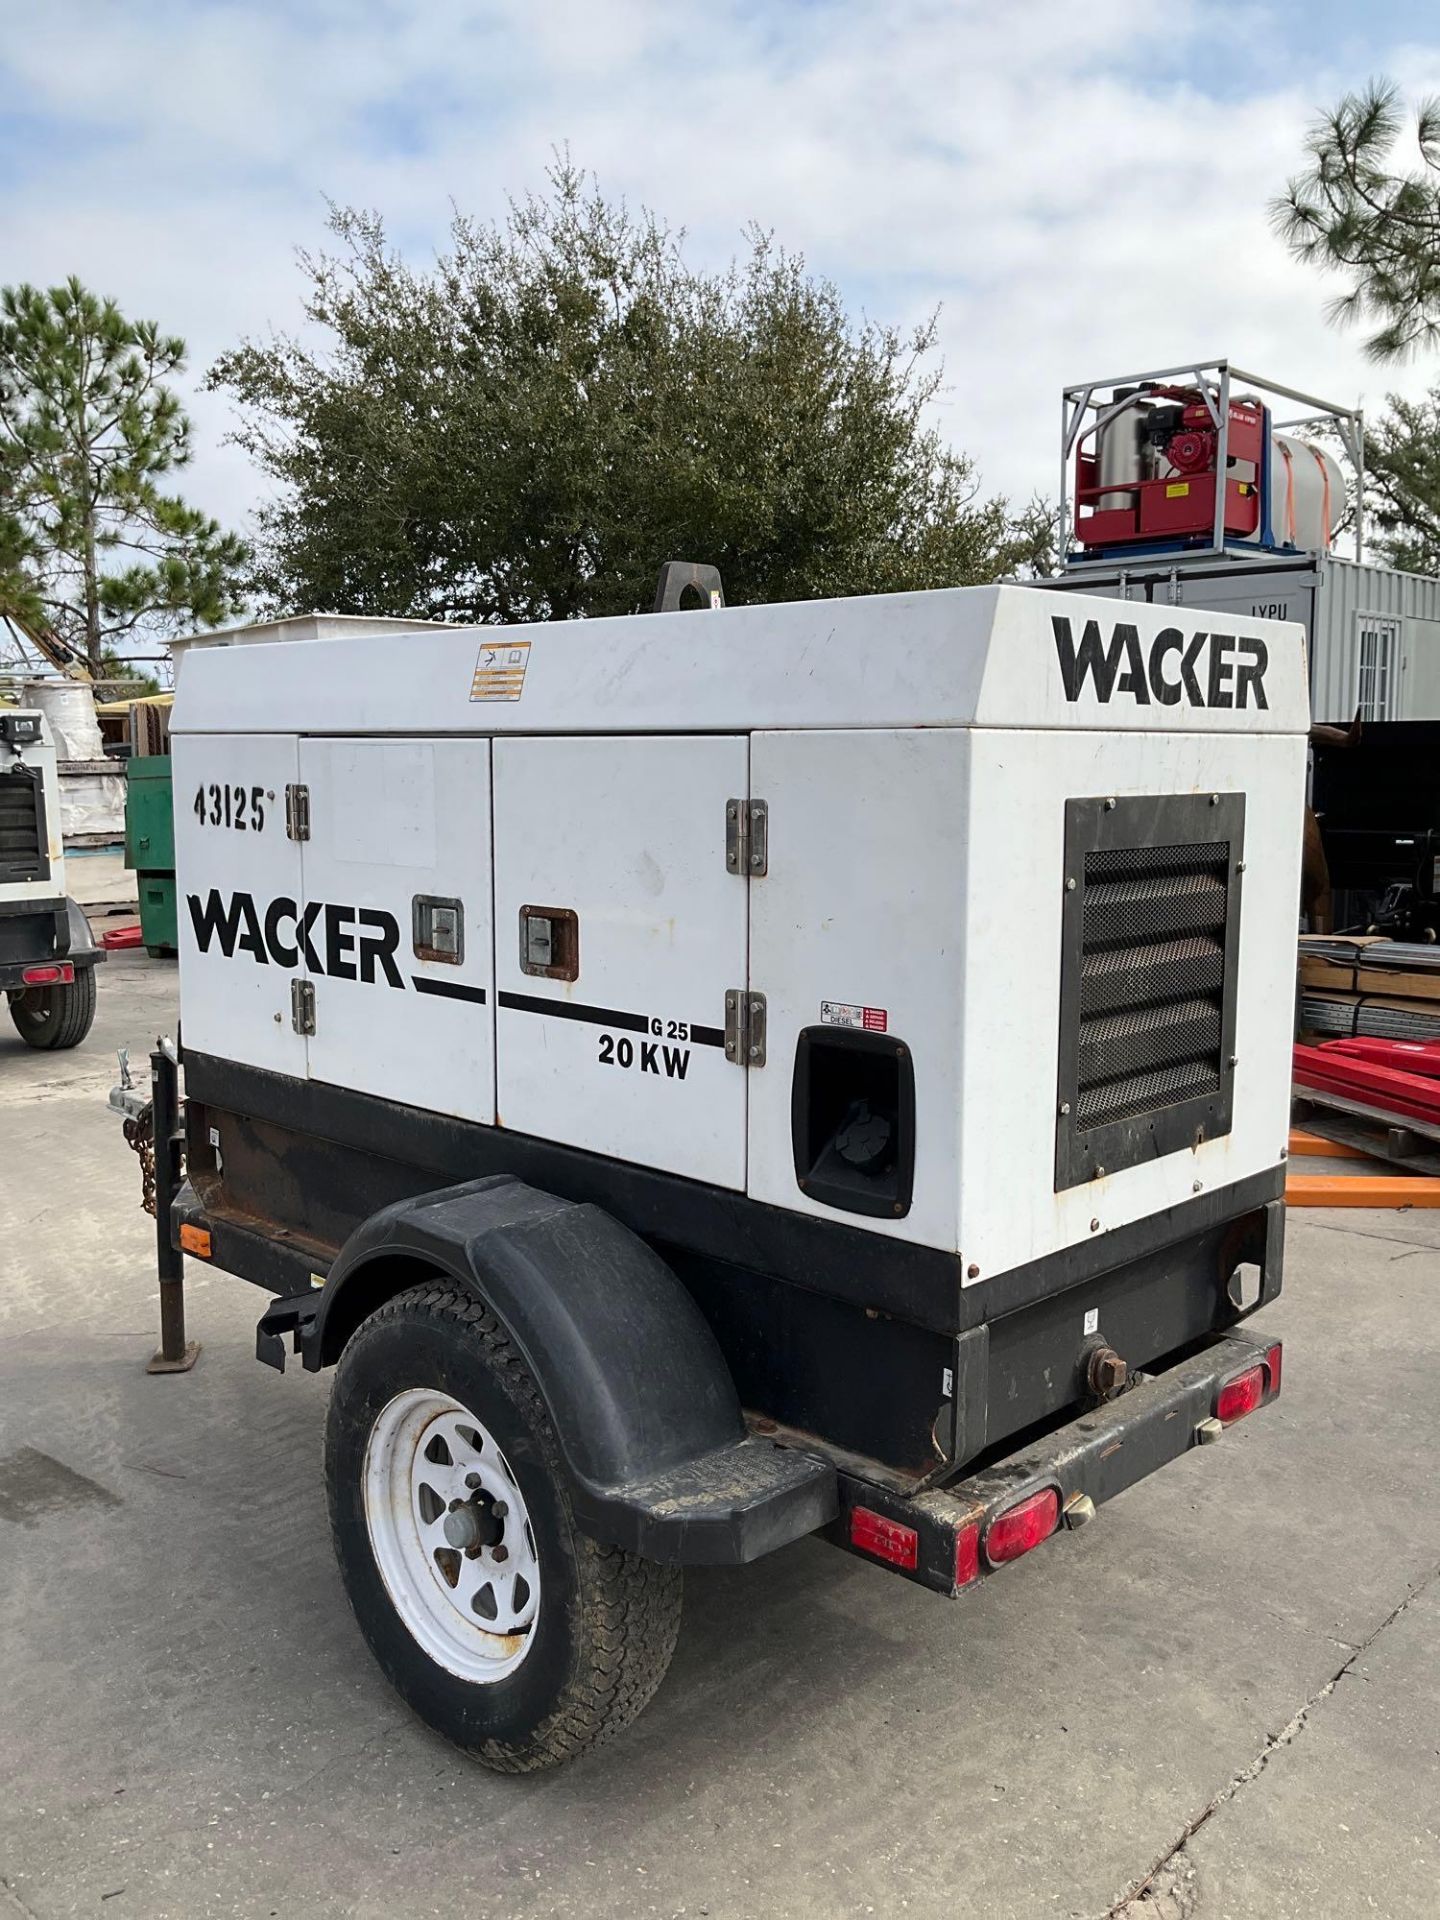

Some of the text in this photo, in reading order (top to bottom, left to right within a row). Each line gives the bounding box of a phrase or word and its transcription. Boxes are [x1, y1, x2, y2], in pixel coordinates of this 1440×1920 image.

[1051, 615, 1269, 710] WACKER
[194, 783, 264, 832] 43125
[186, 888, 405, 989] WACKER
[651, 1018, 688, 1041] G 25
[831, 1016, 853, 1026] DIESEL
[598, 1034, 690, 1080] 20 KW
